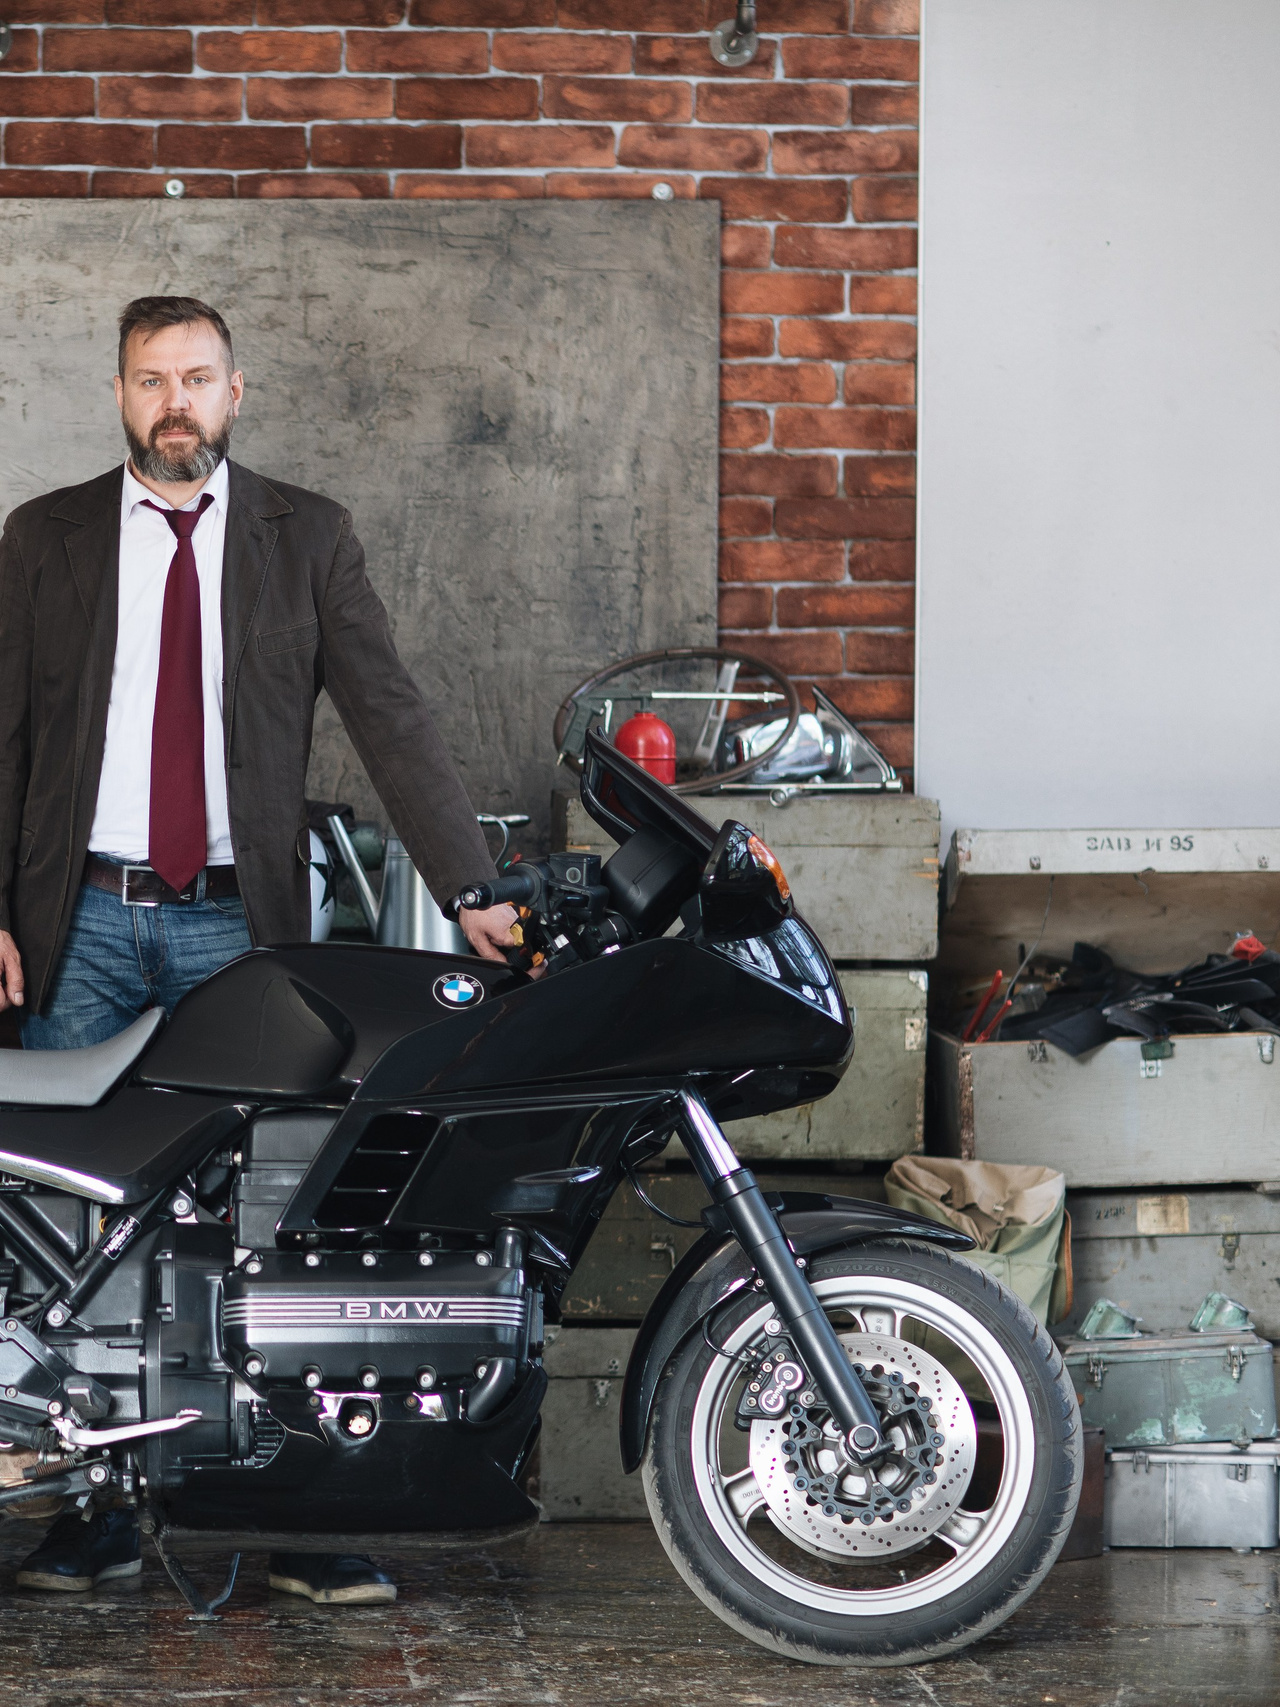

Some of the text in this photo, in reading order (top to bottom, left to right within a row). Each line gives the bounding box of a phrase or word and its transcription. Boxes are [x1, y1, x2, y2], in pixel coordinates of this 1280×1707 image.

[1170, 835, 1194, 851] 95
[440, 974, 480, 988] BMW
[346, 1302, 444, 1319] BMW
